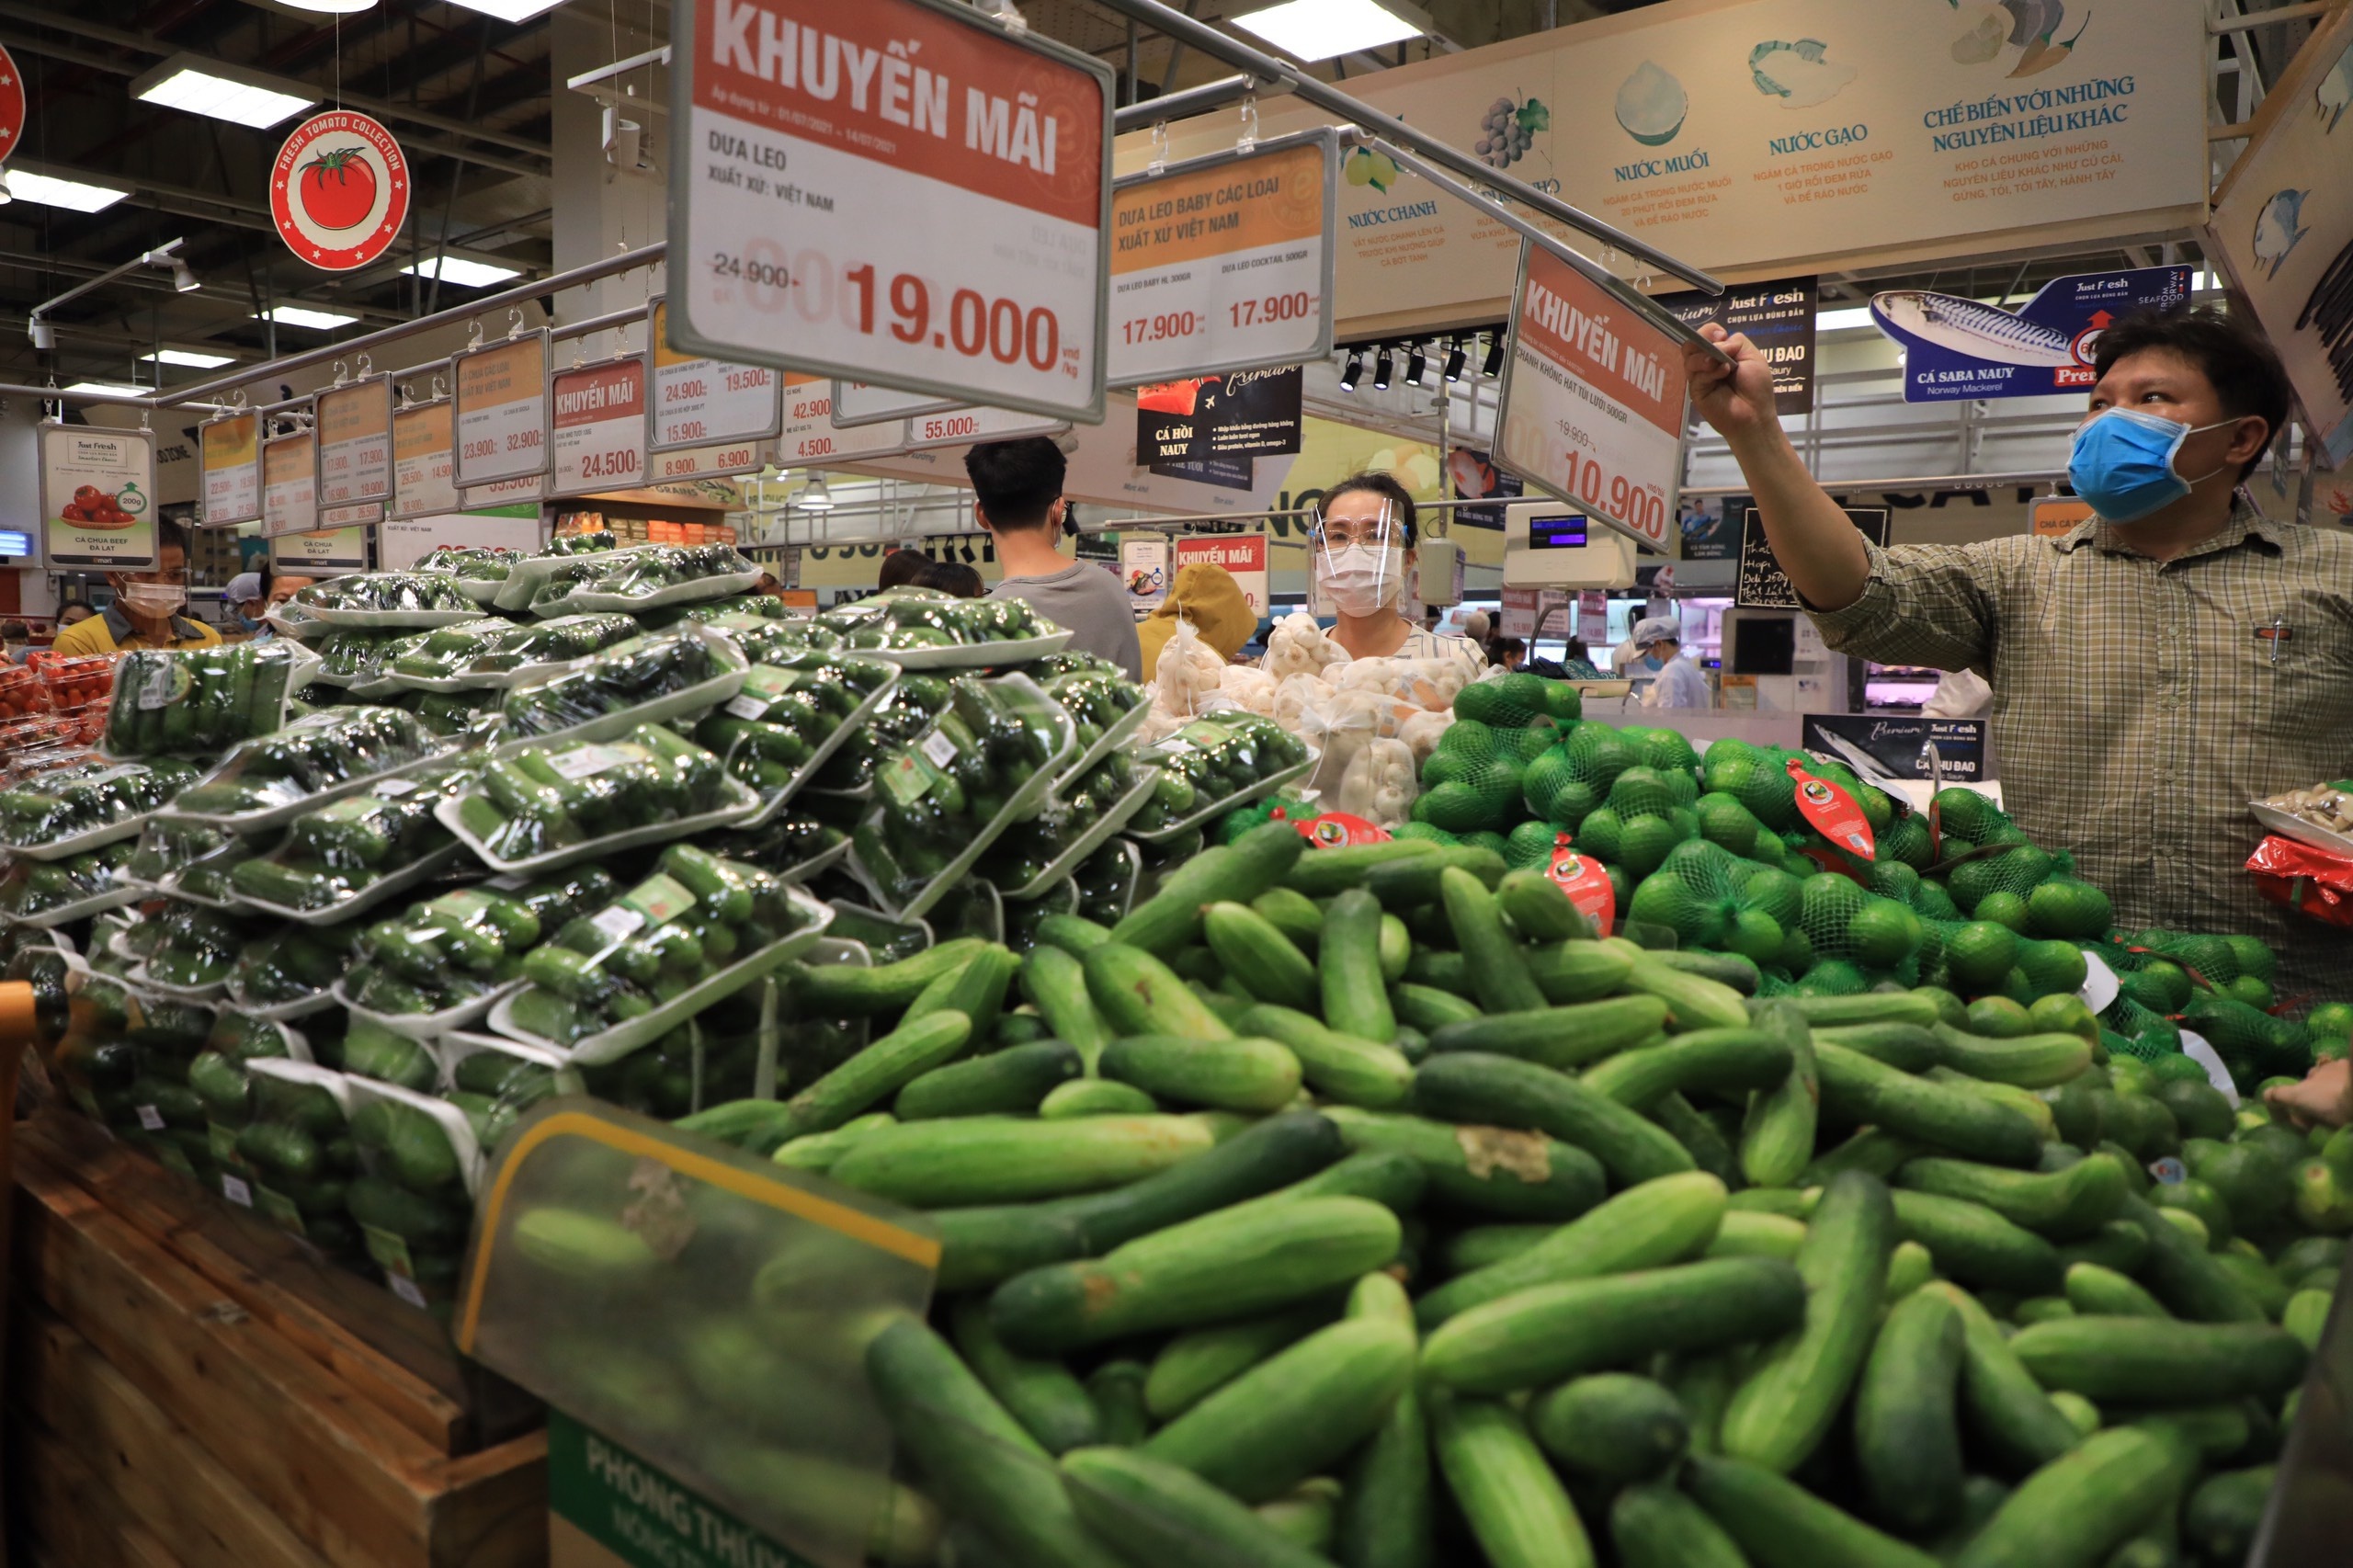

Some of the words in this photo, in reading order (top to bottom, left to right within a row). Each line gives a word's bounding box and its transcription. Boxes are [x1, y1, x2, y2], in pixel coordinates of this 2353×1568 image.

[712, 0, 948, 140] KHUYẾN
[966, 87, 1057, 176] MÃI
[1924, 99, 1964, 130] CHẾ
[1967, 94, 2011, 122] BIẾN
[2014, 88, 2052, 113] VỚI
[2056, 75, 2135, 106] NHỮNG
[1769, 131, 1823, 155] NƯỚC
[1824, 123, 1869, 147] GẠO
[1933, 121, 2016, 153] NGUYÊN
[2019, 114, 2063, 139] LIỆU
[2066, 103, 2129, 131] KHÁC
[279, 134, 305, 171] FRESH
[305, 116, 347, 137] TOMATO
[352, 119, 402, 171] COLLECTION
[709, 130, 749, 162] DƯA
[754, 143, 787, 172] LEO
[1614, 159, 1662, 182] NƯỚC
[1665, 147, 1710, 175] MUỐI
[1754, 168, 1782, 182] NGÂM
[1784, 165, 1798, 176] CÁ
[1801, 160, 1836, 173] TRONG
[1837, 154, 1869, 168] NƯỚC
[1870, 150, 1893, 164] GẠO
[1955, 160, 1979, 172] KHO
[1982, 156, 1996, 167] CÁ
[1999, 151, 2040, 165] CHUNG
[2042, 145, 2063, 158] VỚI
[1645, 187, 1676, 199] TRONG
[1677, 181, 1706, 194] NƯỚC
[1708, 176, 1732, 188] MUỐI
[1824, 174, 1847, 185] ĐEM
[1943, 174, 1989, 189] NGUYÊN
[1991, 168, 2016, 182] LIỆU
[2018, 164, 2051, 178] KHÁC
[2052, 160, 2079, 173] NHƯ
[2095, 169, 2116, 181] TÂY
[775, 182, 802, 206] VIỆT
[806, 192, 835, 213] NAM
[1120, 207, 1145, 228] DƯA
[1149, 199, 1173, 221] LEO
[1176, 191, 1213, 214] BABY
[1216, 183, 1243, 206] CÁC
[1247, 176, 1279, 200] LOẠI
[1676, 198, 1696, 208] ĐEM
[1837, 184, 1869, 197] NƯỚC
[1347, 209, 1385, 229] NƯỚC
[1388, 200, 1438, 222] CHANH
[1682, 209, 1710, 220] NƯỚC
[1118, 225, 1150, 254] XUẤT
[1176, 217, 1205, 242] VIỆT
[1209, 211, 1239, 232] NAM
[713, 251, 790, 290] 24.900
[1237, 260, 1250, 271] LEO
[1251, 255, 1283, 269] COCKTAIL
[2076, 282, 2096, 292] Just
[2097, 278, 2129, 290] Fresh
[1230, 290, 1309, 329] 17.900
[1729, 295, 1756, 311] Just
[1759, 287, 1804, 307] Fresh
[846, 263, 1059, 372] 19.000
[1122, 311, 1195, 346] 17.900
[1727, 315, 1747, 325] CHỌN
[1525, 278, 1620, 373] KHUYẾN
[1623, 350, 1666, 403] MÃI
[1776, 346, 1805, 363] ĐAO
[665, 380, 702, 403] 24.900
[725, 368, 765, 392] 19.500
[1516, 346, 1539, 369] CHANH
[1540, 361, 1563, 384] KHÔNG
[1563, 377, 1577, 394] HẠT
[1578, 384, 1589, 402] TÚI
[1589, 394, 1606, 412] LƯỚI
[1607, 403, 1628, 424] 500GR
[1917, 369, 1936, 384] CÁ
[1938, 369, 1974, 382] SABA
[1977, 367, 2015, 381] NAUY
[1927, 384, 1961, 395] Norway
[1962, 382, 2003, 393] Mackerel
[556, 380, 604, 416] KHUYẾN
[608, 376, 633, 404] MÃI
[793, 398, 831, 419] 42.900
[667, 421, 702, 442] 15.900
[925, 416, 972, 440] 55.000
[1155, 426, 1170, 440] CÁ
[1172, 424, 1194, 439] HỒI
[1558, 418, 1589, 447] 19.900
[94, 442, 117, 450] Fresh
[359, 449, 383, 466] 17.900
[463, 438, 494, 460] 23.900
[506, 429, 540, 451] 32.900
[798, 437, 832, 458] 4.500
[1159, 443, 1188, 457] NAUY
[582, 449, 635, 479] 24.500
[665, 458, 695, 476] 8.900
[718, 449, 749, 469] 6.900
[122, 497, 142, 506] 200g
[1564, 449, 1665, 540] 10.900
[1178, 544, 1226, 565] KHUYẾN
[1229, 545, 1253, 564] MÃI
[1871, 721, 1925, 741] Premium
[1931, 723, 1948, 733] Just
[1953, 760, 1975, 772] ĐAO
[585, 1432, 692, 1538] PHONG
